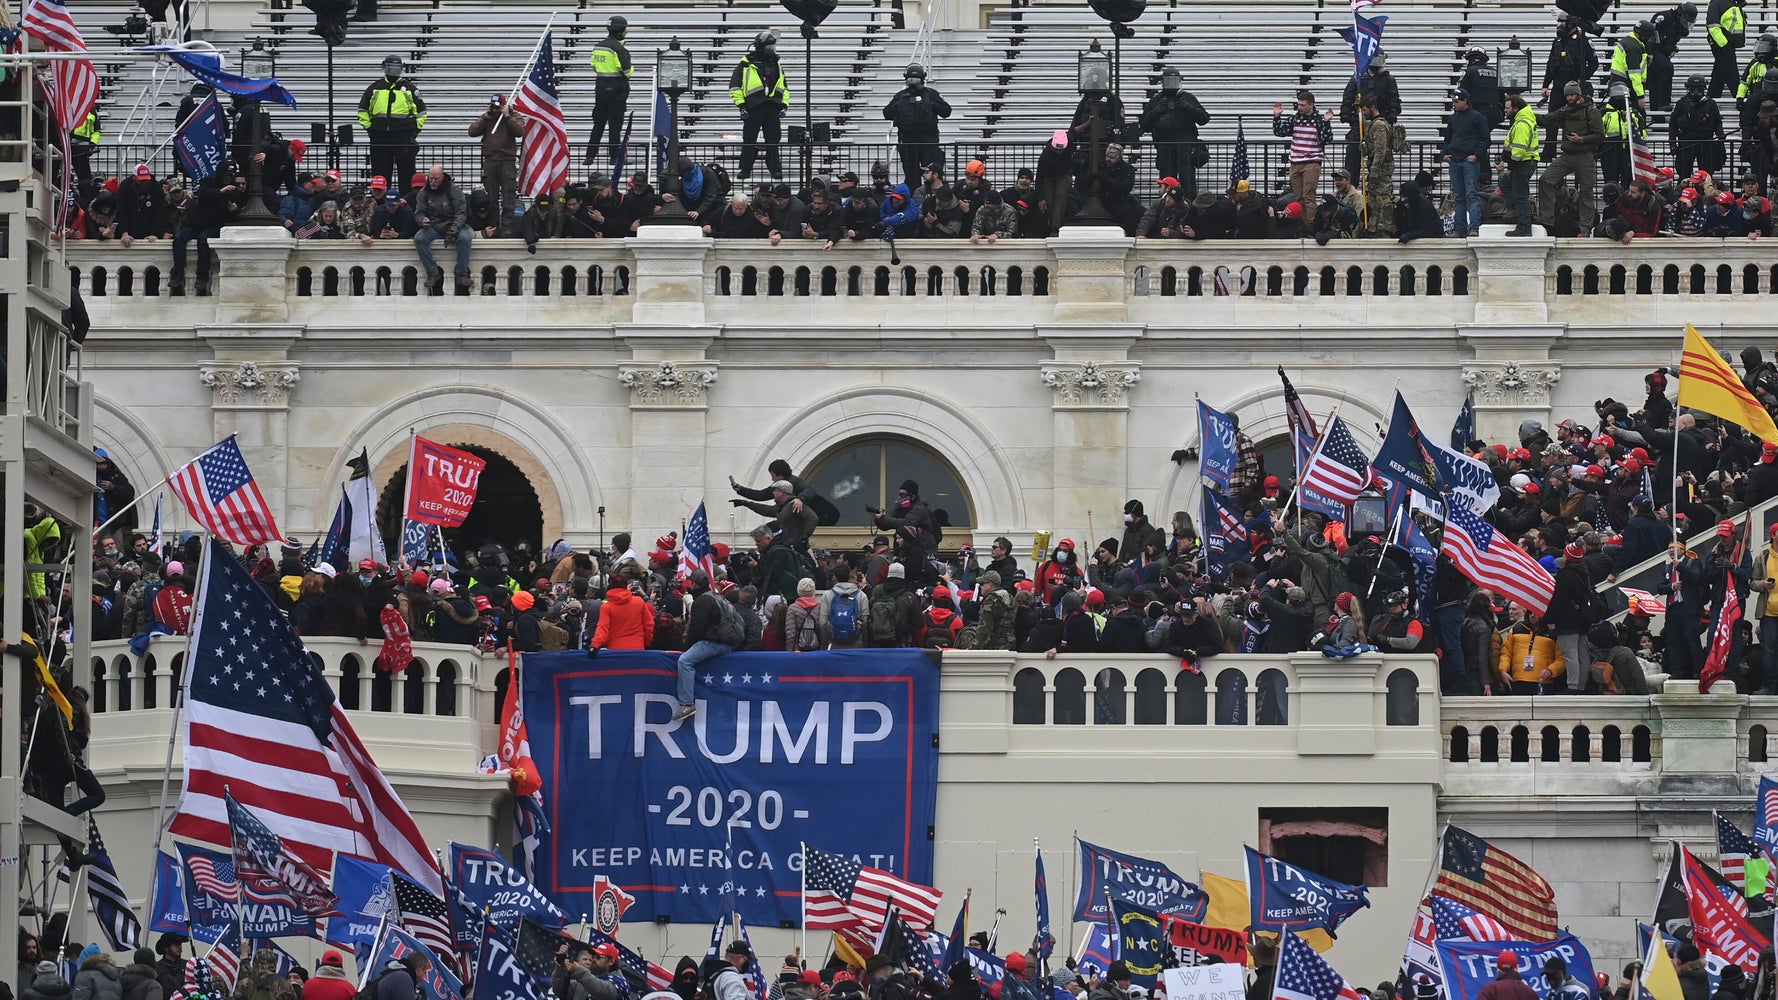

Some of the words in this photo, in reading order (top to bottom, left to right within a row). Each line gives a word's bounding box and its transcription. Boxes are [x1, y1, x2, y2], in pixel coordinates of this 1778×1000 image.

[182, 135, 196, 153] KEEP
[193, 154, 209, 179] AMERIC
[1389, 459, 1406, 475] KEEP
[419, 500, 443, 511] KEEP
[568, 692, 895, 765] TRUMP
[571, 847, 643, 868] KEEP
[650, 847, 774, 871] AMERCA
[786, 851, 896, 874] GAT!
[489, 909, 519, 920] MERICA
[1267, 909, 1293, 918] KEEP
[243, 921, 289, 934] RUMP
[349, 922, 381, 938] TRU
